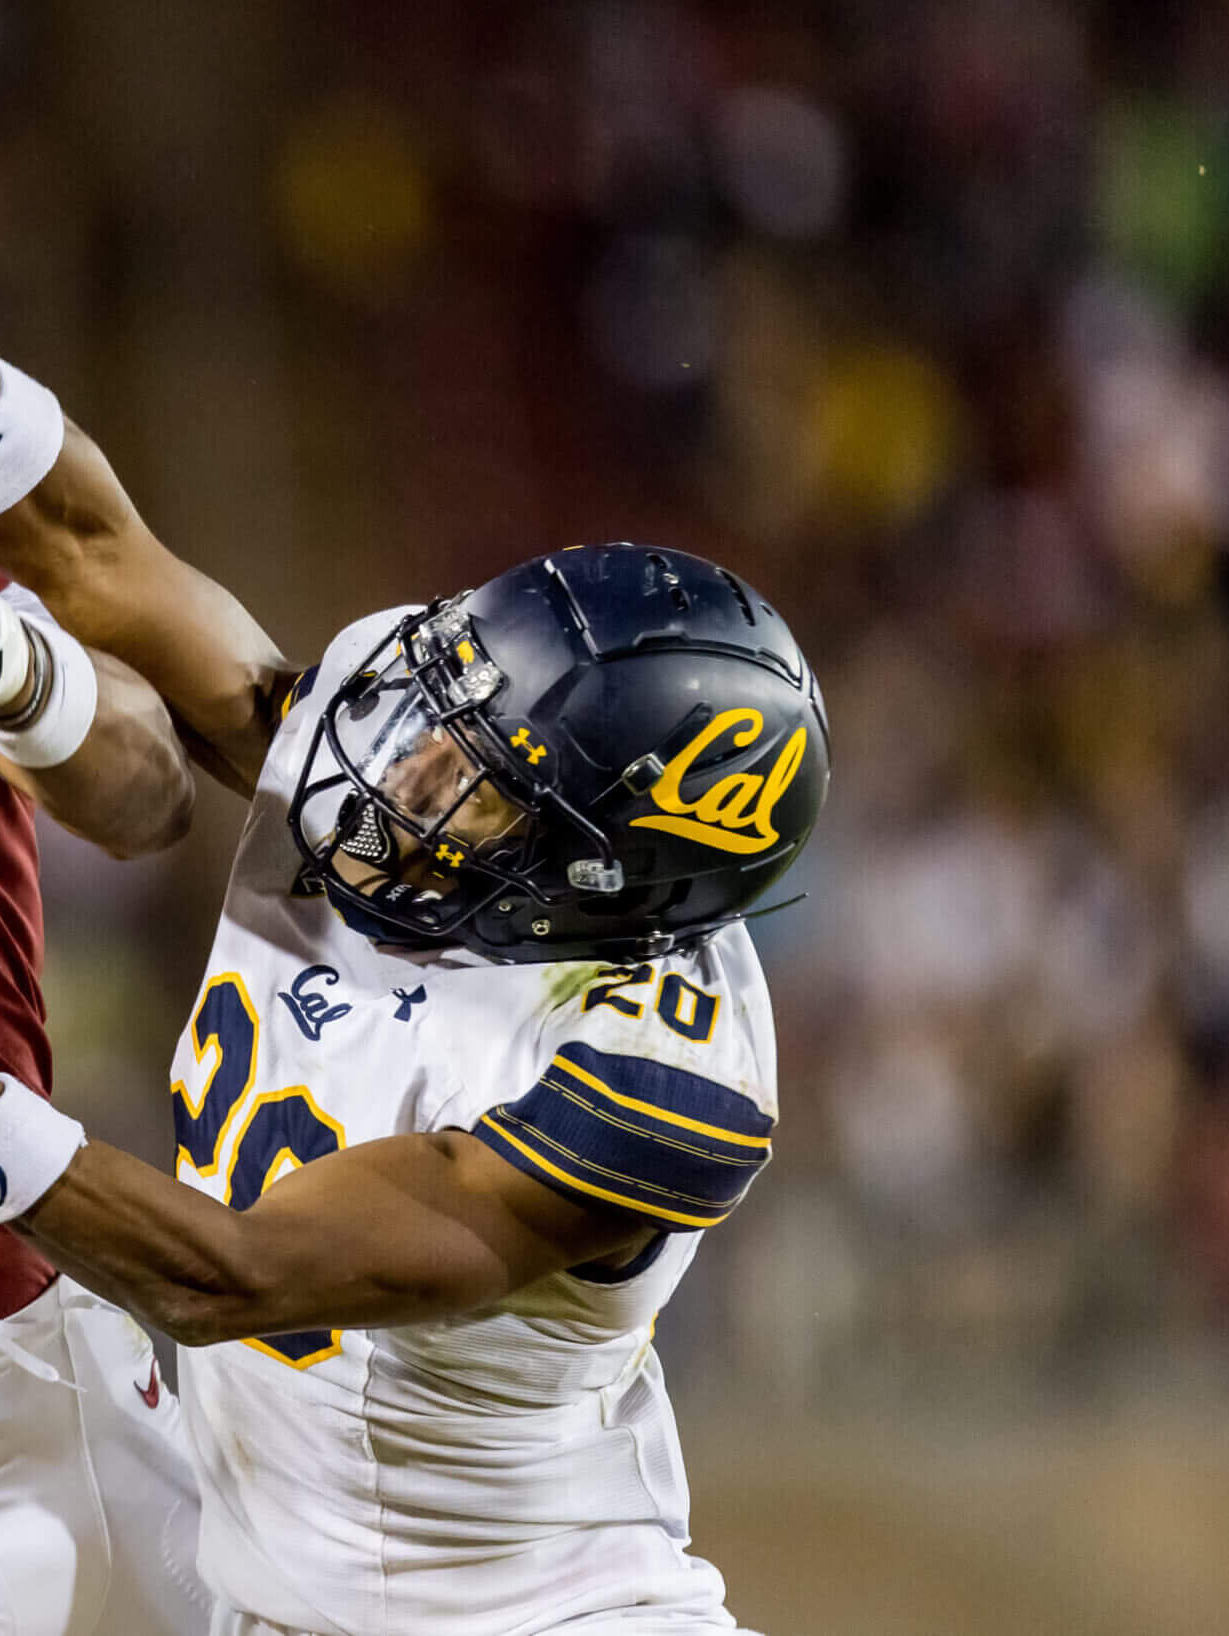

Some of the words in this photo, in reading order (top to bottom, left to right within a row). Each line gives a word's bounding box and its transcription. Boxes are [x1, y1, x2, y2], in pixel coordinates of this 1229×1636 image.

[628, 707, 808, 855] Cal
[277, 964, 353, 1042] Cal
[580, 962, 722, 1045] 20
